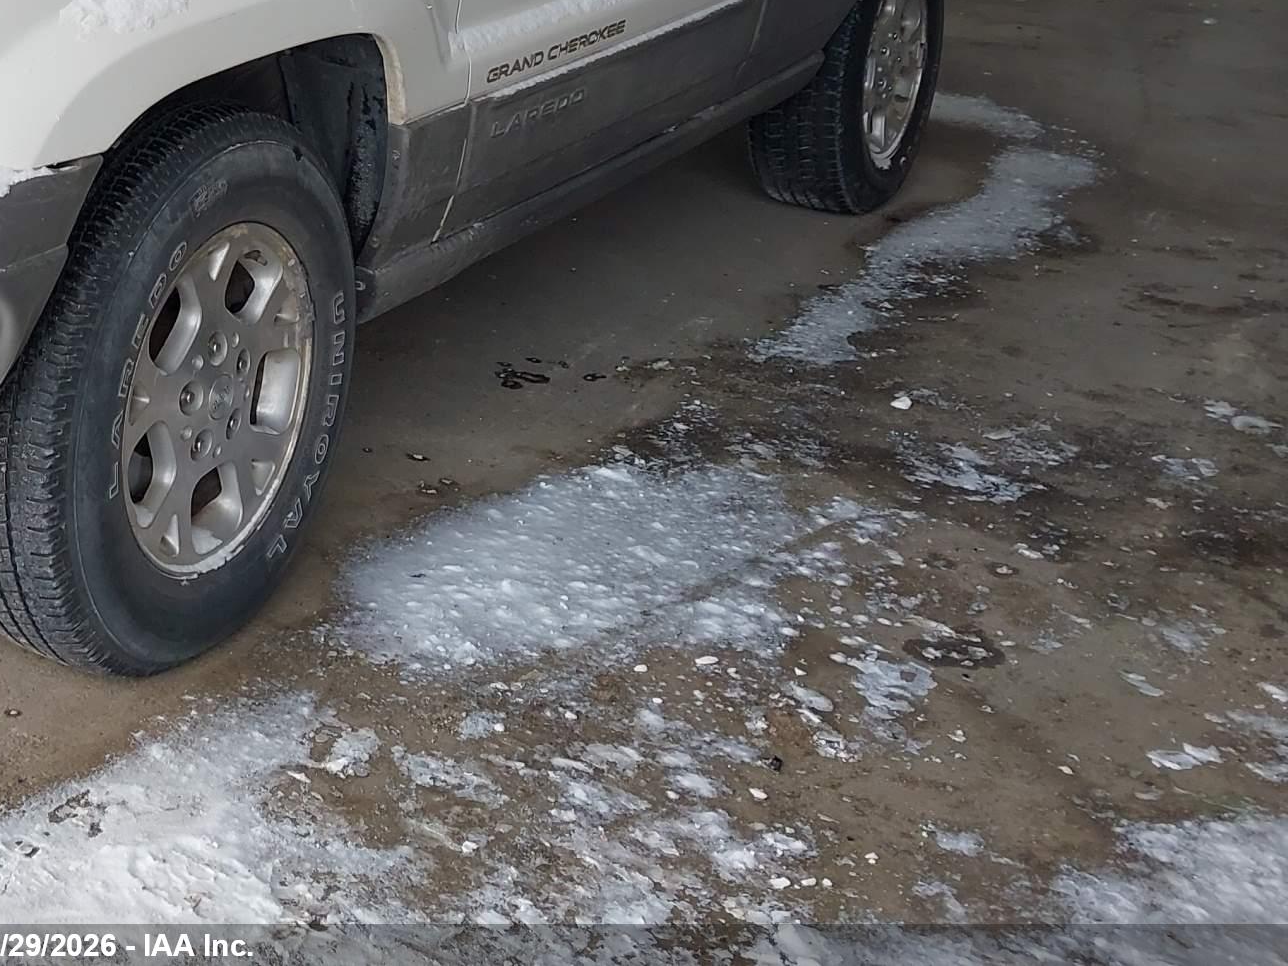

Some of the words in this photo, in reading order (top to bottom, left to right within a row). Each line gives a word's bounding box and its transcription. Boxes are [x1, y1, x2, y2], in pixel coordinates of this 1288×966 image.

[486, 51, 544, 83] GRAND
[548, 19, 626, 61] CHEROKEE
[491, 88, 585, 138] LAREDO
[109, 242, 187, 499] LAREDO
[266, 290, 345, 559] UNIROYAL
